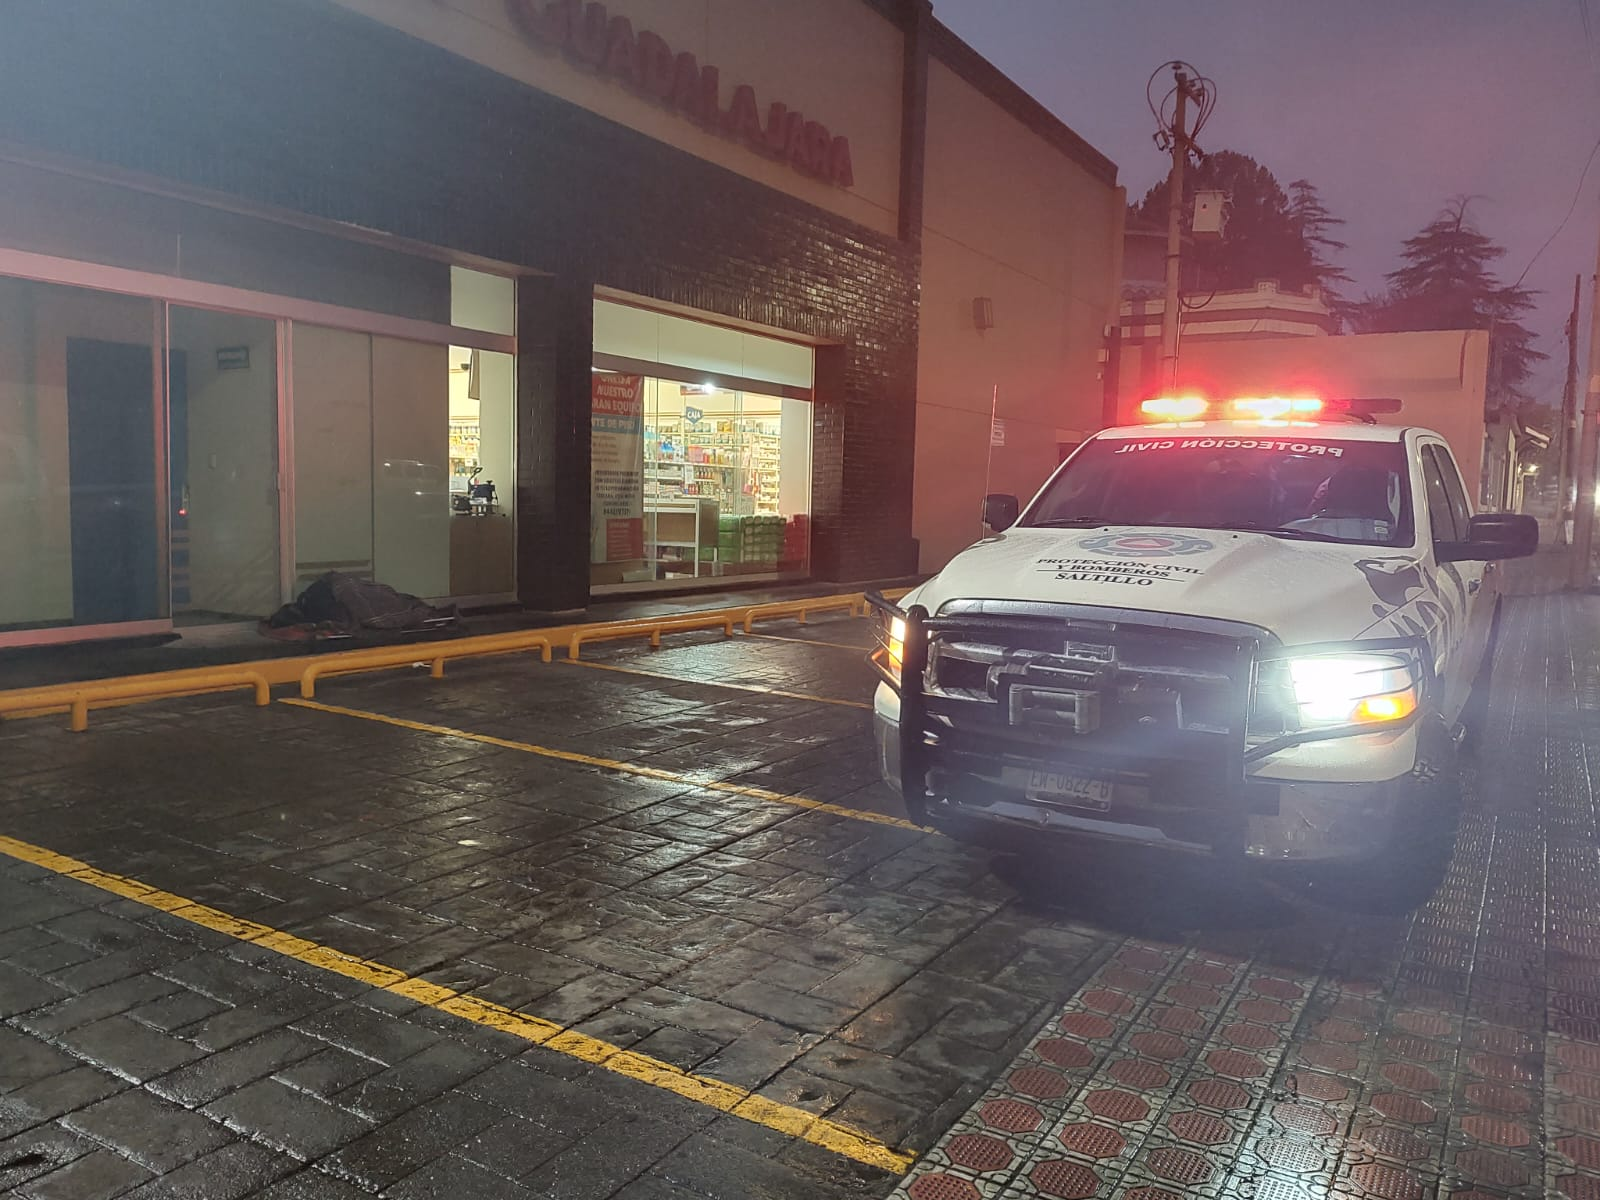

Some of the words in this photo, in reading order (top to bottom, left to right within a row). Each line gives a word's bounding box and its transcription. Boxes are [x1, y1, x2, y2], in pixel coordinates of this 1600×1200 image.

[597, 385, 634, 398] NUESTRO
[1037, 558, 1149, 568] PROTECCIÓN
[1149, 564, 1205, 575] CIVIL
[1070, 565, 1171, 577] BOMBEROS
[1055, 573, 1154, 586] SALTILLO
